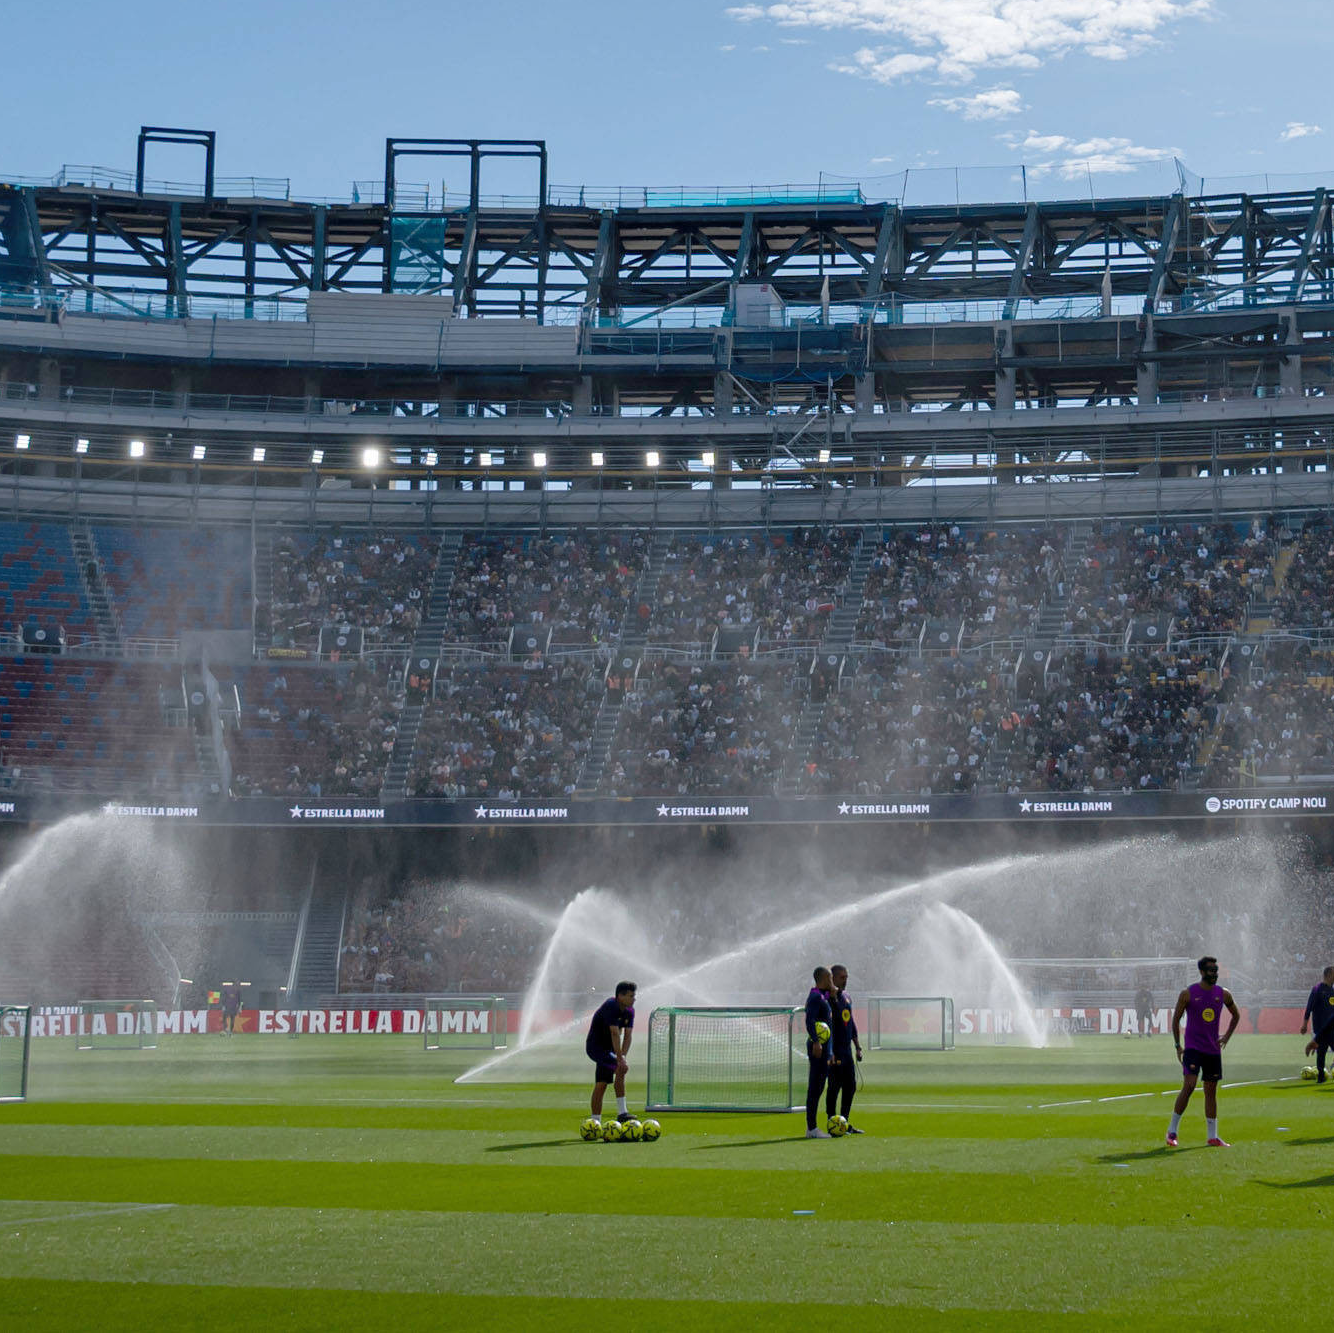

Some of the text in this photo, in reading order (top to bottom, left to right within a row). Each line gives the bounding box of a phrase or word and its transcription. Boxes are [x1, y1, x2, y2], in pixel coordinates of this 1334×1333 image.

[1033, 802, 1112, 812] ESTRELLA DAMM
[1222, 797, 1326, 810] SPOTIFY CAMP NOU
[118, 806, 198, 817] ESTRELLA DAMM
[305, 809, 384, 818] ESTRELLA DAMM
[489, 809, 567, 818] ESTRELLA DAMM
[671, 806, 748, 816] ESTRELLA DAMM
[852, 804, 930, 814] ESTRELLA DAMM
[117, 1010, 207, 1034] DAMM
[259, 1010, 488, 1033] ESTRELLA DAMM
